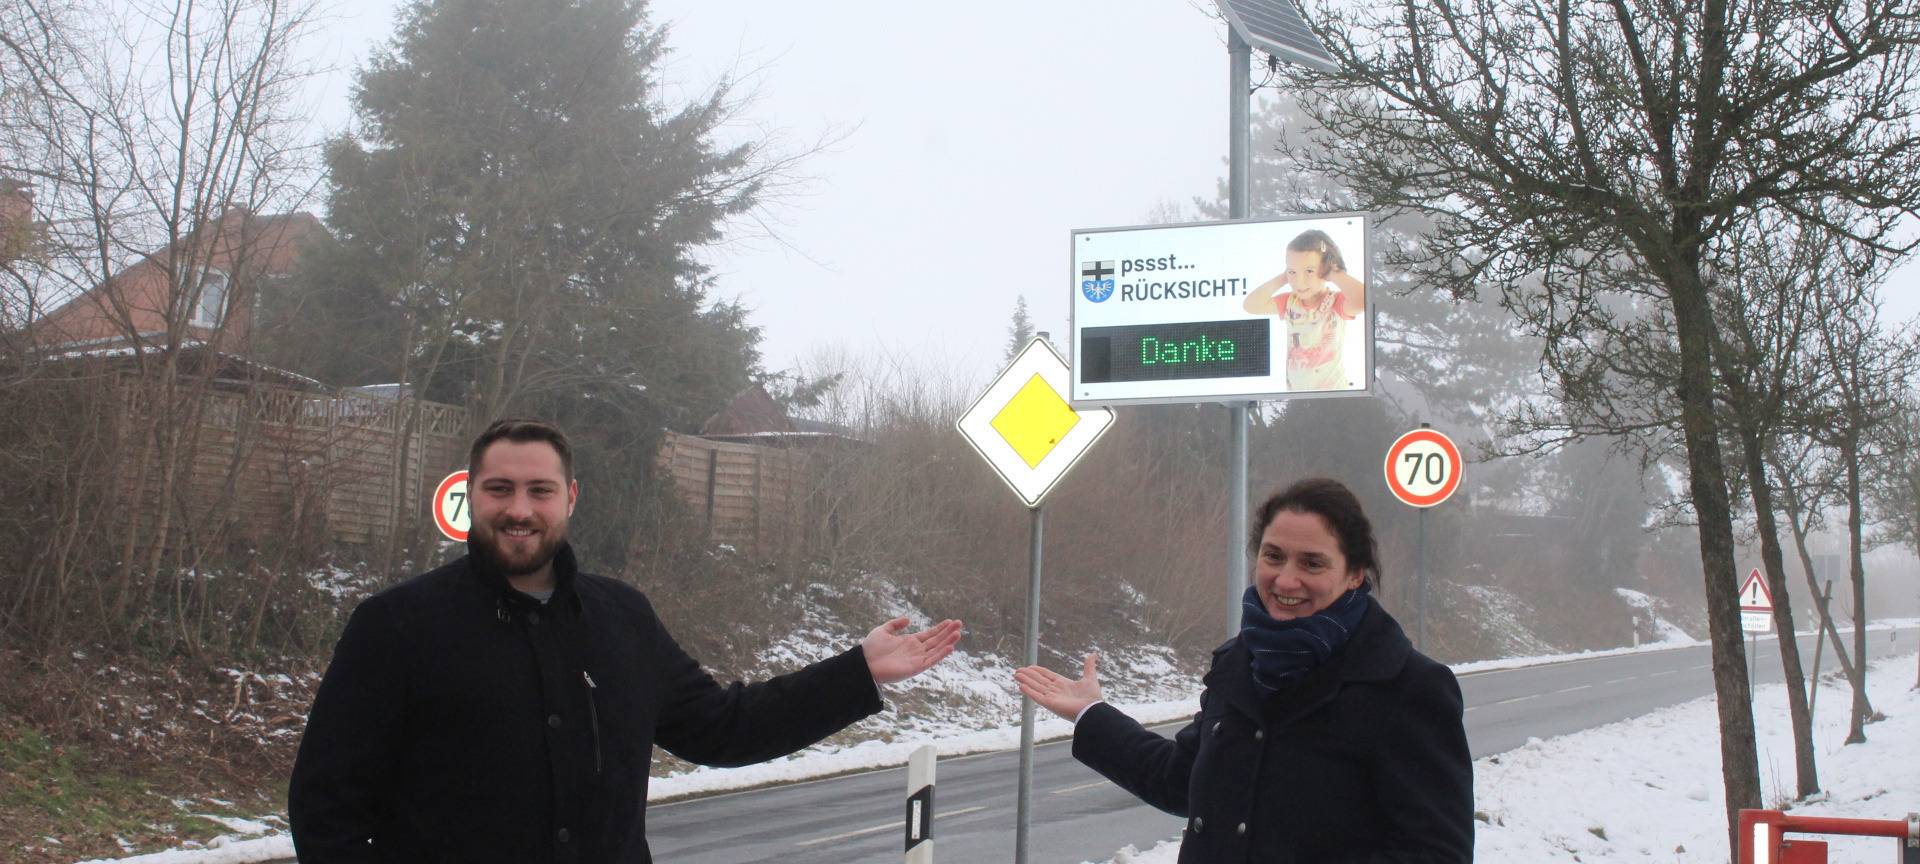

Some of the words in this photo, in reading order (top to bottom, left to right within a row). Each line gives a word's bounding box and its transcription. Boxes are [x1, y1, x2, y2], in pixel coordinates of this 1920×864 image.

[1121, 254, 1195, 277] pssst...
[1121, 277, 1247, 302] RÜCKSICHT!
[1142, 335, 1235, 365] Danke
[1405, 452, 1444, 485] 70
[450, 492, 471, 522] 7
